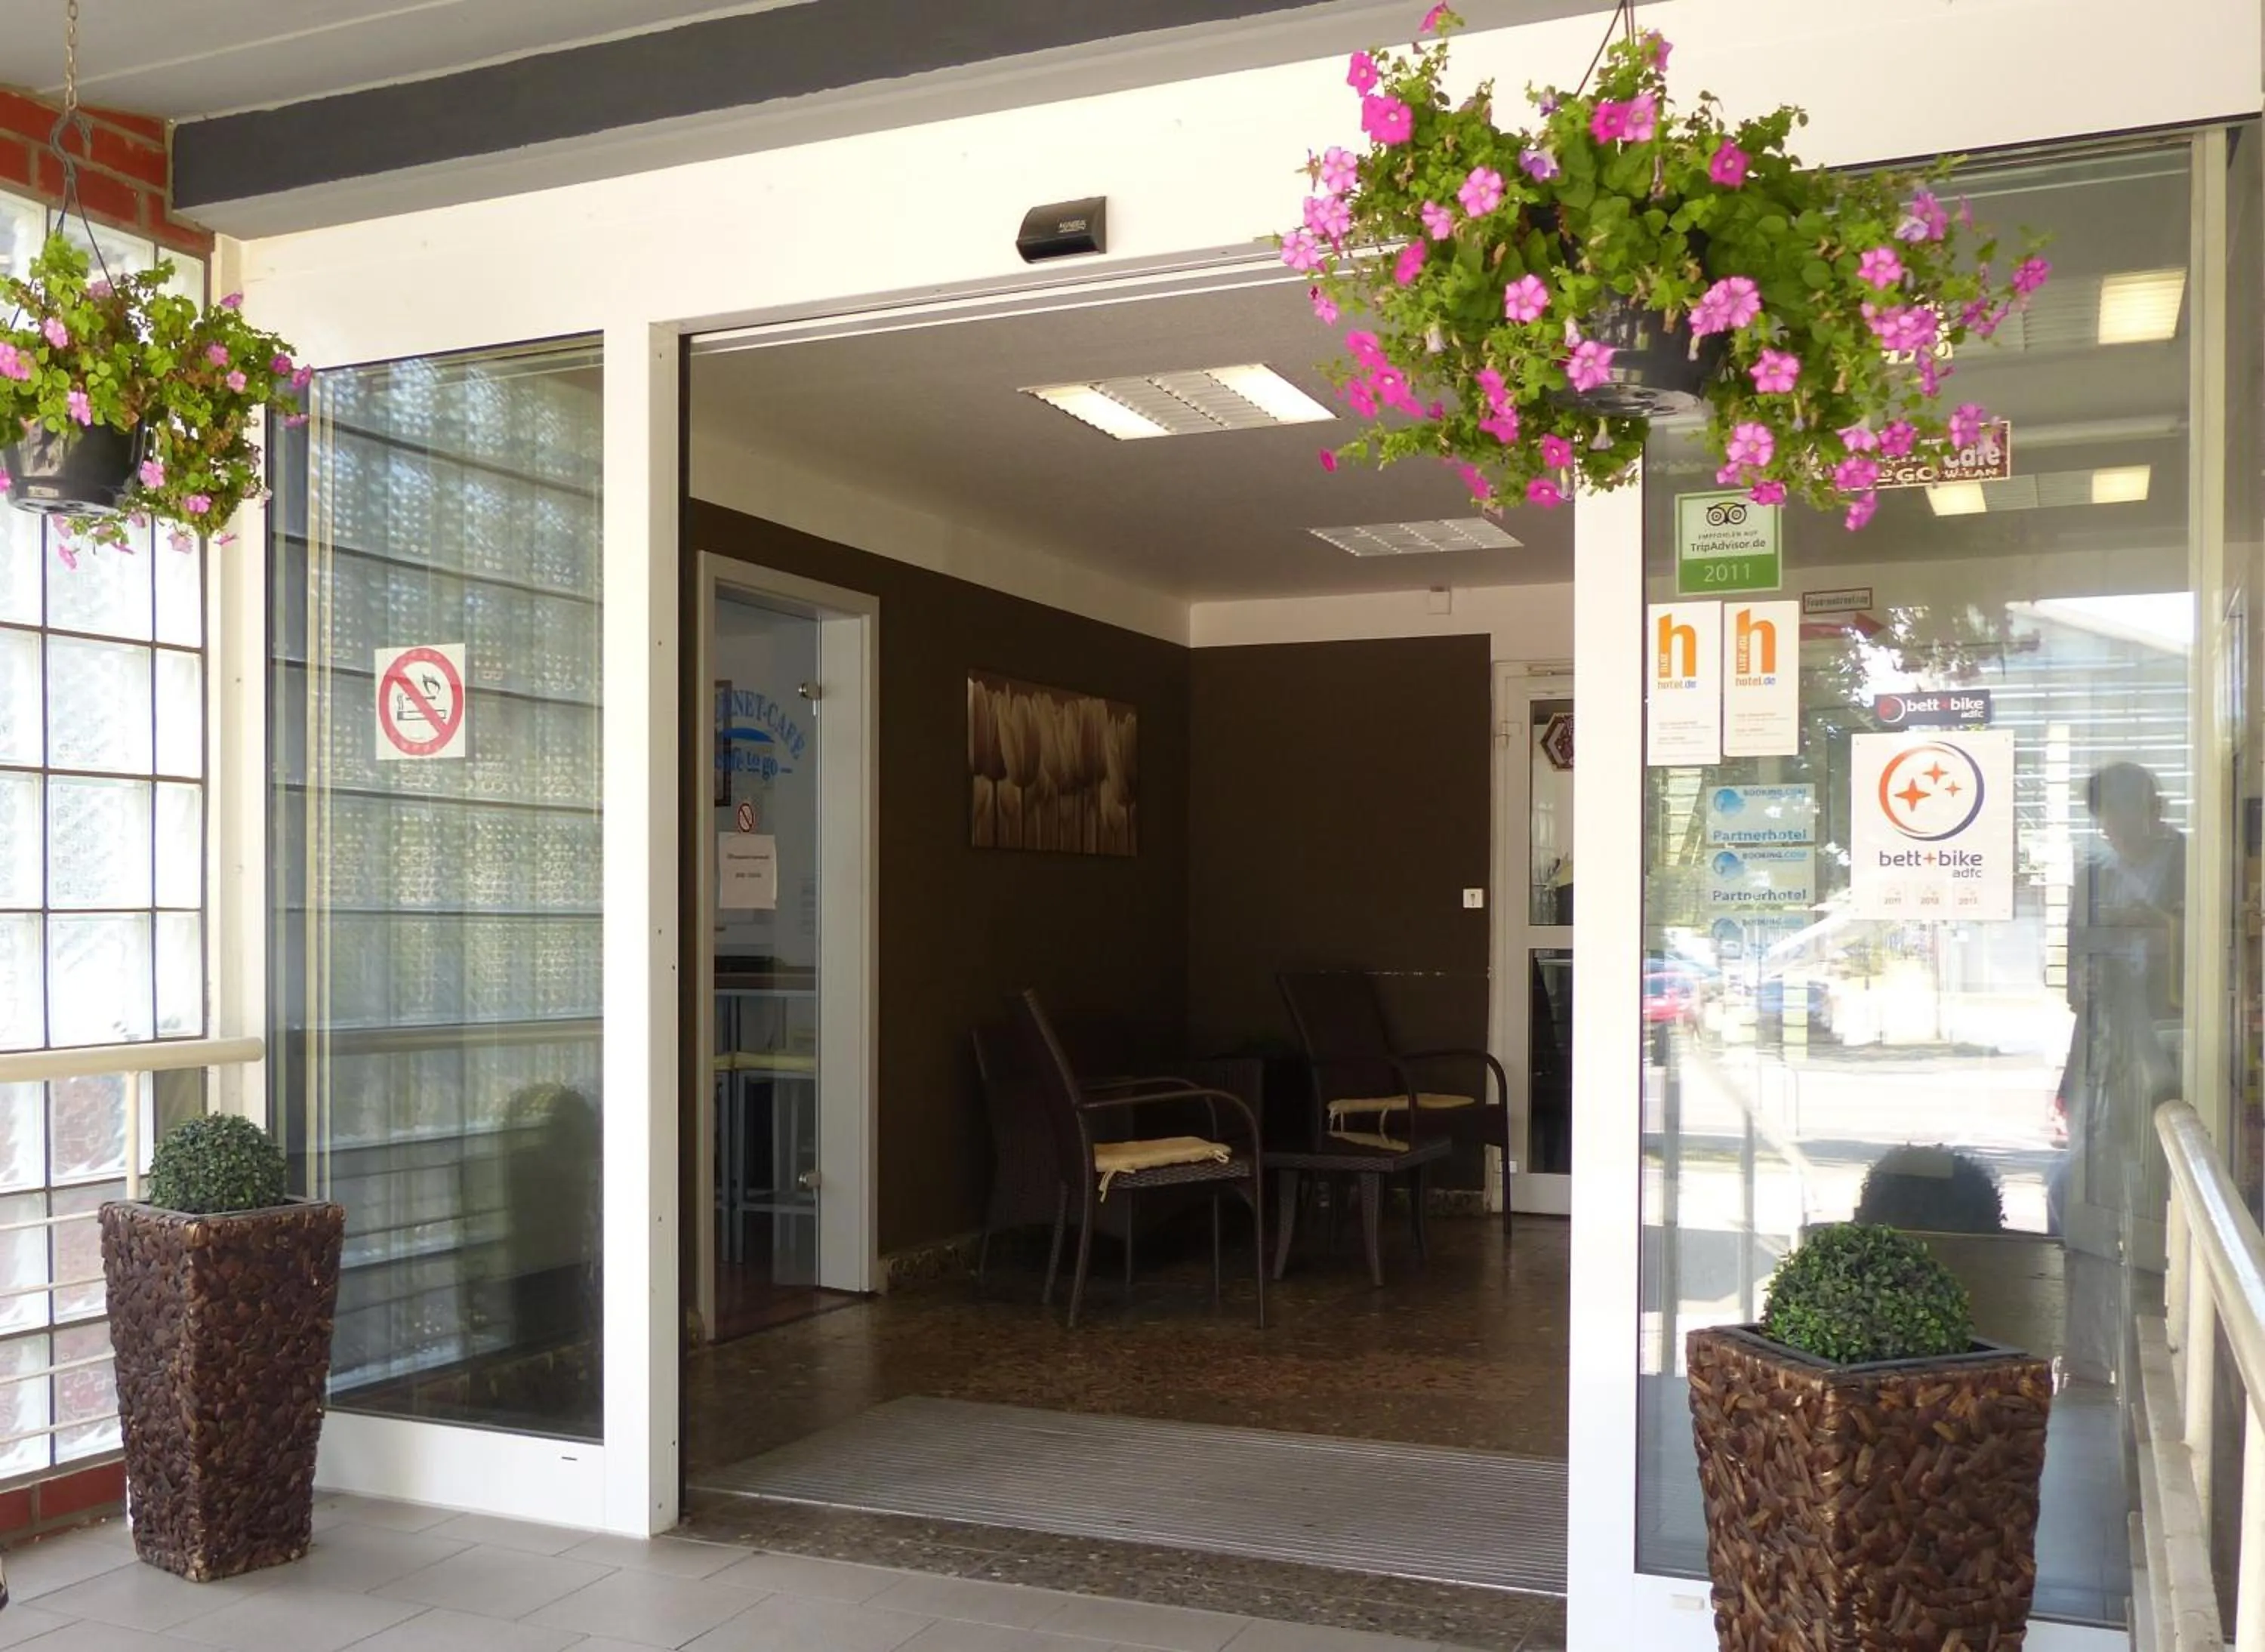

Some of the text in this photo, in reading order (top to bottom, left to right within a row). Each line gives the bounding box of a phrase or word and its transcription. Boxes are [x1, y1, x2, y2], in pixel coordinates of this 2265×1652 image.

[1944, 468, 1997, 479] W-LAN
[1690, 538, 1766, 552] TripAdvisor.de
[1703, 562, 1751, 583] 2011
[1657, 680, 1696, 689] hotel.de
[1735, 677, 1776, 687] hotel.de
[747, 751, 761, 768] to
[762, 757, 779, 781] go
[1712, 829, 1807, 841] Partnerhotel
[1952, 868, 1983, 878] adfc
[1712, 889, 1807, 901] Partnerhotel
